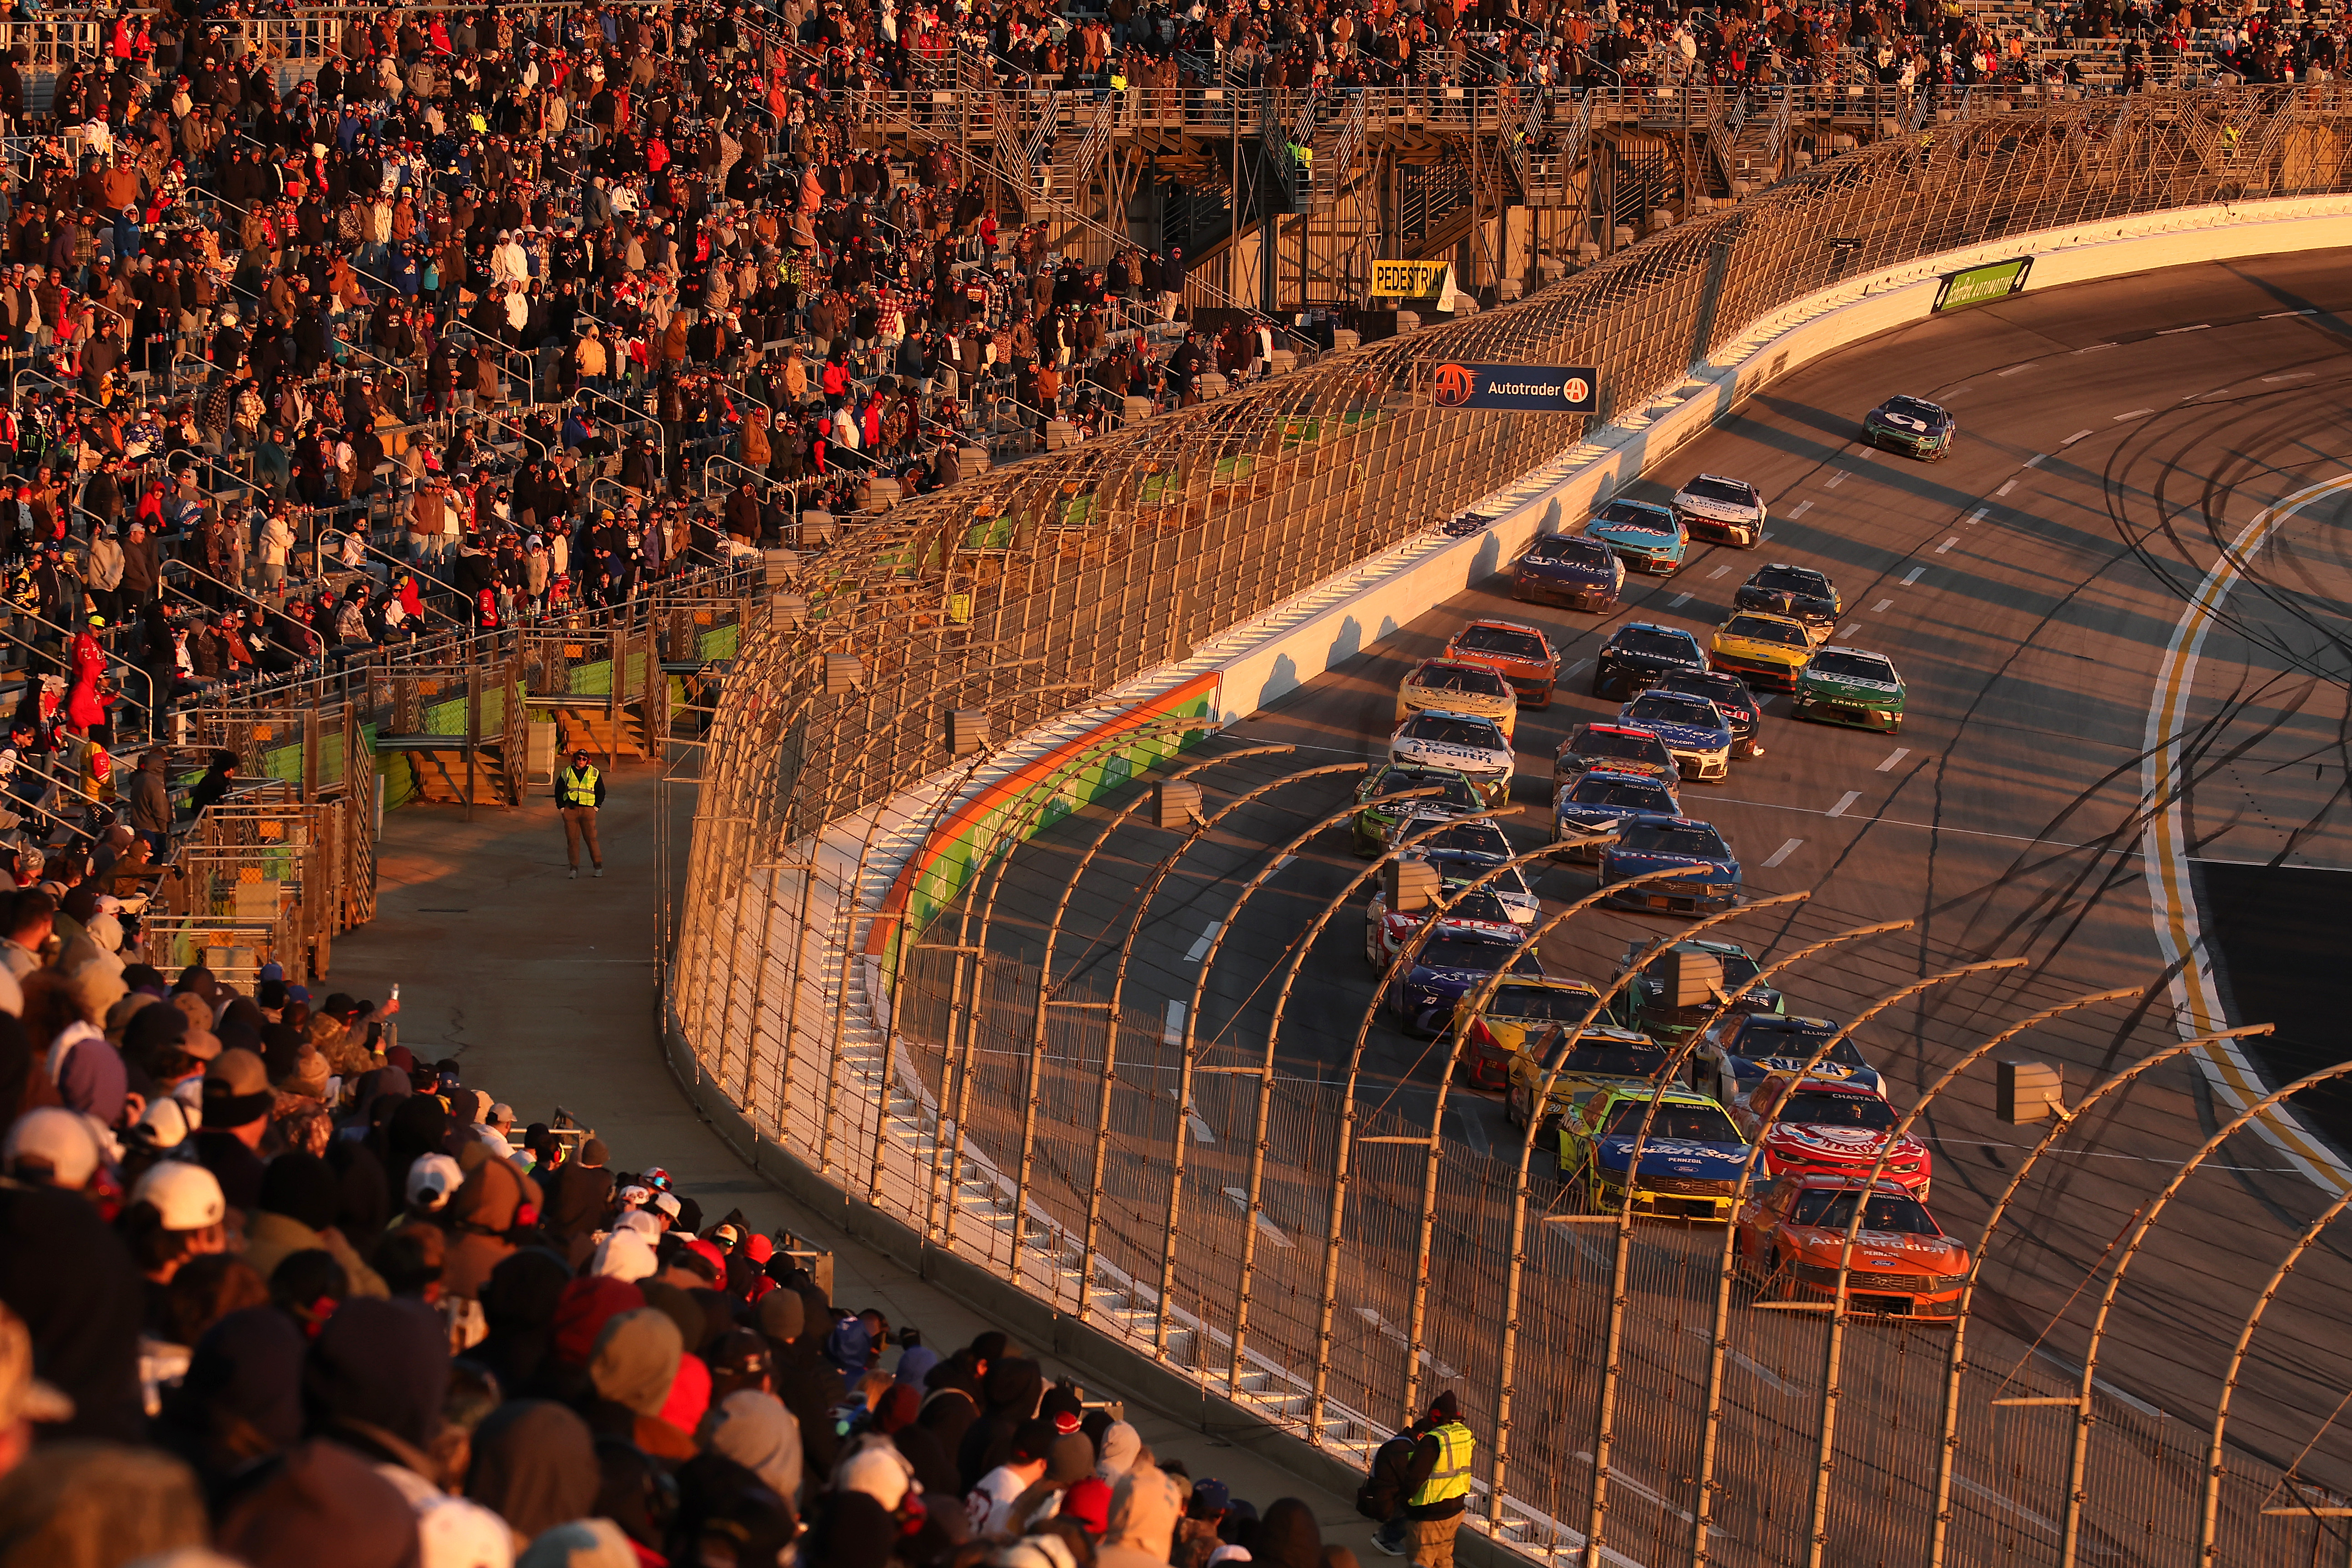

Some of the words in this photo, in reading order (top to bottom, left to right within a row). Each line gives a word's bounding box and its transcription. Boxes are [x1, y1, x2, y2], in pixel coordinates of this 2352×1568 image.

[1936, 283, 1949, 307] 4
[1946, 276, 1976, 305] EchoPark
[1971, 275, 2015, 298] AUTOMOTIVE
[2014, 264, 2029, 288] 4
[1488, 381, 1560, 396] Autotrader
[1915, 405, 1936, 413] BOWMAN
[1856, 658, 1887, 666] NEMECHEK
[1831, 699, 1866, 708] CAMRY
[1629, 721, 1717, 739] Freeway
[1412, 745, 1494, 765] Health
[1625, 784, 1661, 792] HOCEVAR
[1567, 807, 1637, 817] Spectr
[1487, 1060, 1497, 1068] 22
[1547, 1104, 1561, 1112] 20
[1608, 1185, 1619, 1193] 12
